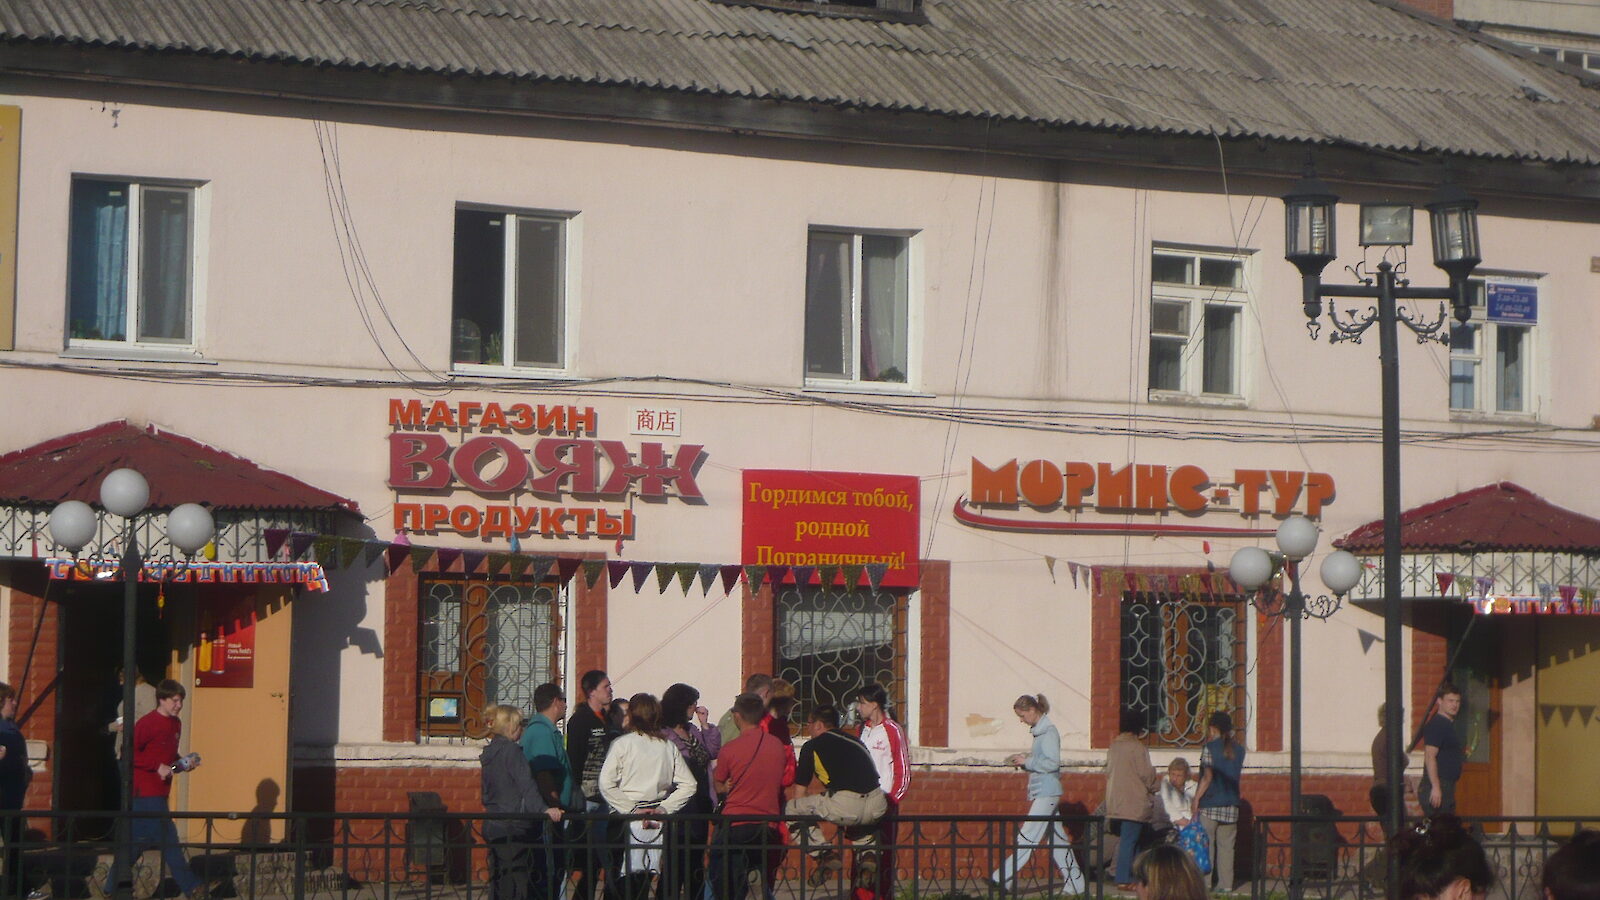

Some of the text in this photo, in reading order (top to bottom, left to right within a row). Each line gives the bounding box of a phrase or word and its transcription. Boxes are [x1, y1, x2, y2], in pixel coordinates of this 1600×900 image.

[388, 398, 595, 432] МАГАЗИН
[636, 408, 676, 431] 商店
[388, 432, 705, 498] ВОЯЖ
[749, 482, 914, 512] Гордимся тобой,
[971, 456, 1336, 517] МОРИНС-ТУР
[393, 502, 634, 538] ПРОДУКТЫ
[795, 519, 870, 541] родной
[756, 545, 905, 570] Пограничный!
